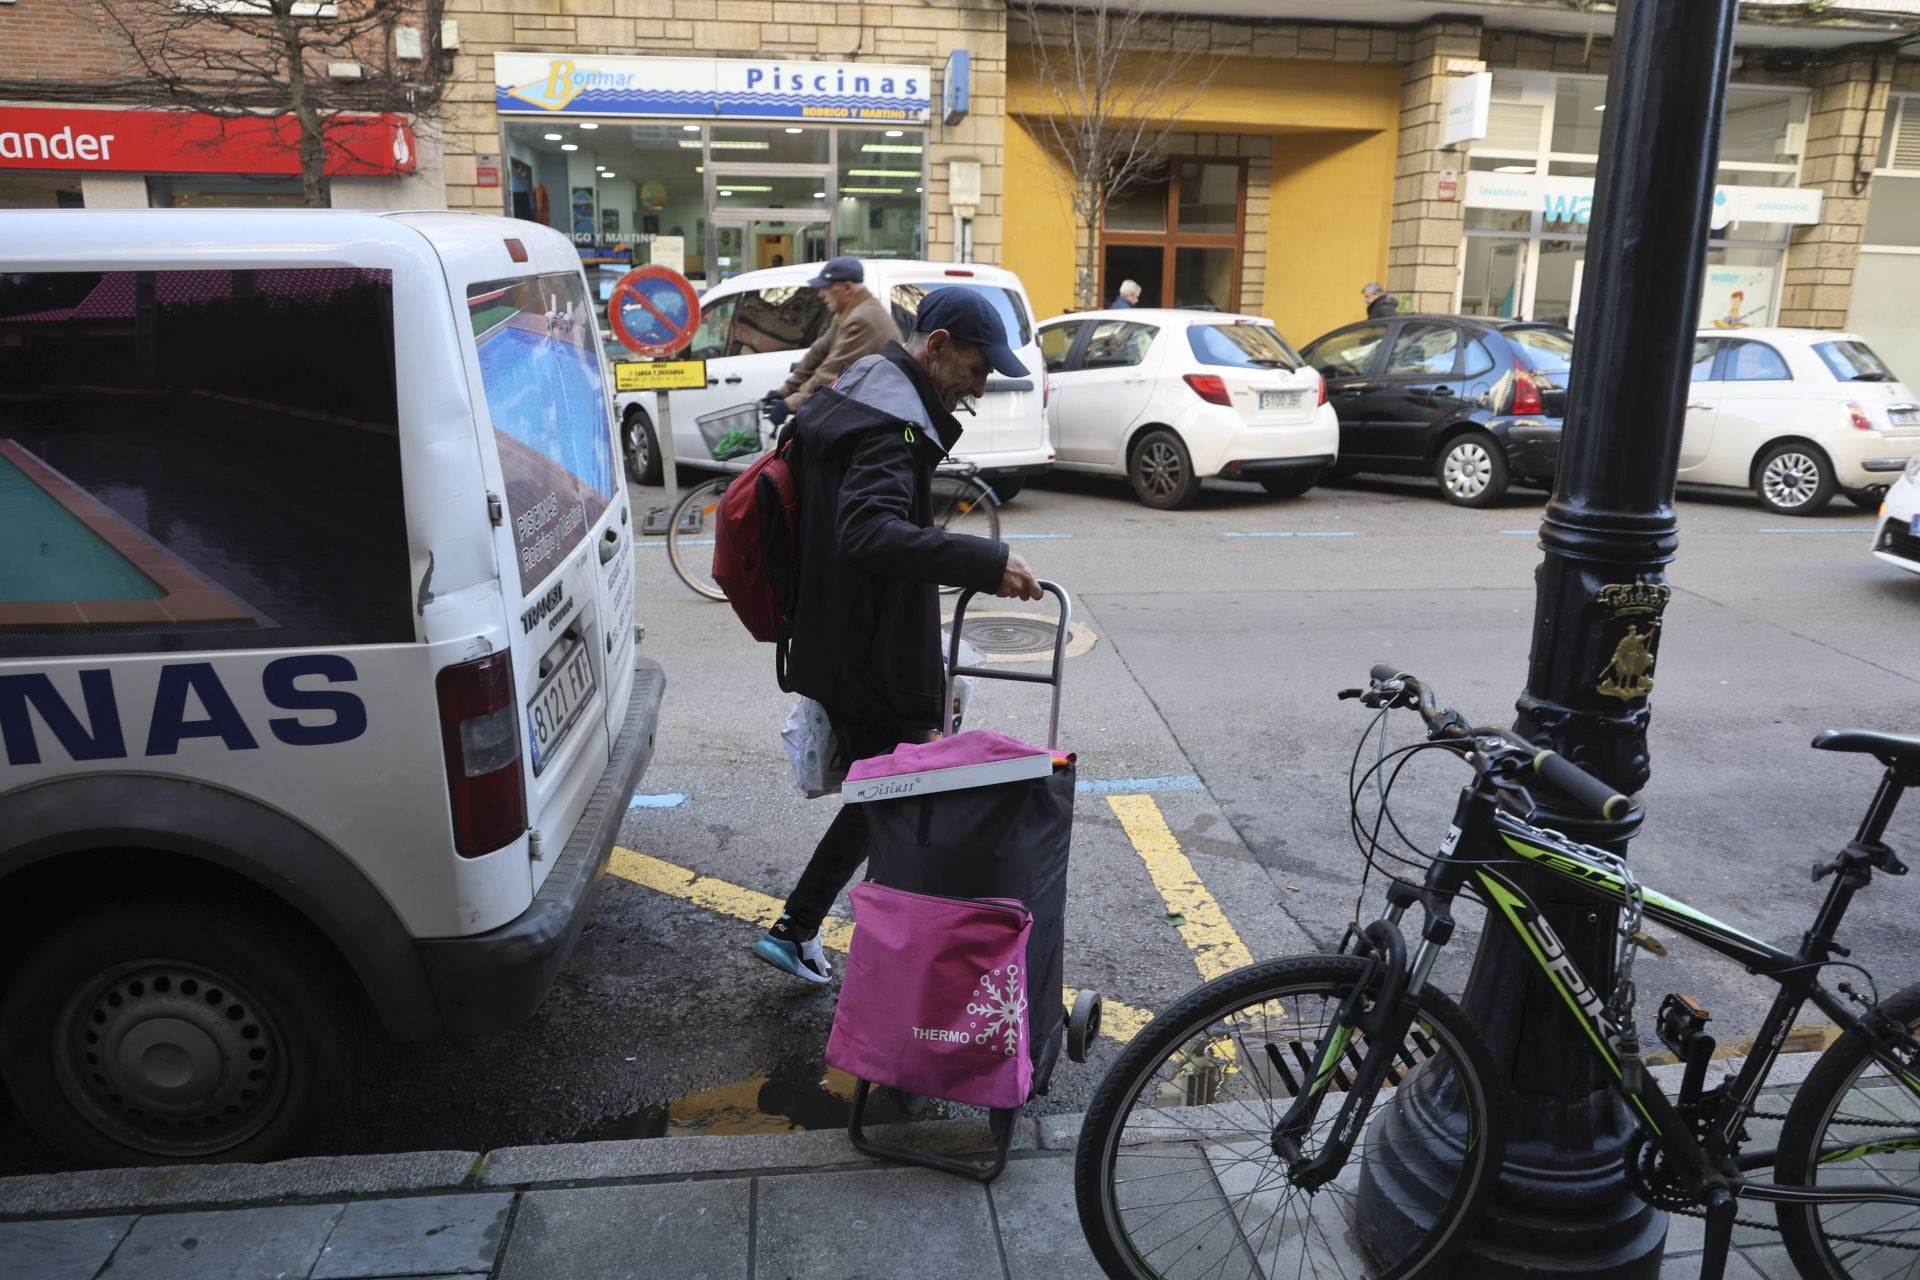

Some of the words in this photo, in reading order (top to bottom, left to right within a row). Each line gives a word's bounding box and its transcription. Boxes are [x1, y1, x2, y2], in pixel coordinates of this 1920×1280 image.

[544, 59, 635, 99] Bonmar
[747, 67, 918, 95] Piscinas
[803, 106, 849, 118] RODRIGO
[850, 108, 857, 118] Y
[860, 108, 905, 119] MARTINO
[516, 492, 557, 542] PISCINAS
[520, 579, 563, 635] TRANSIT
[534, 677, 569, 744] 8121
[912, 1026, 970, 1044] THERMO
